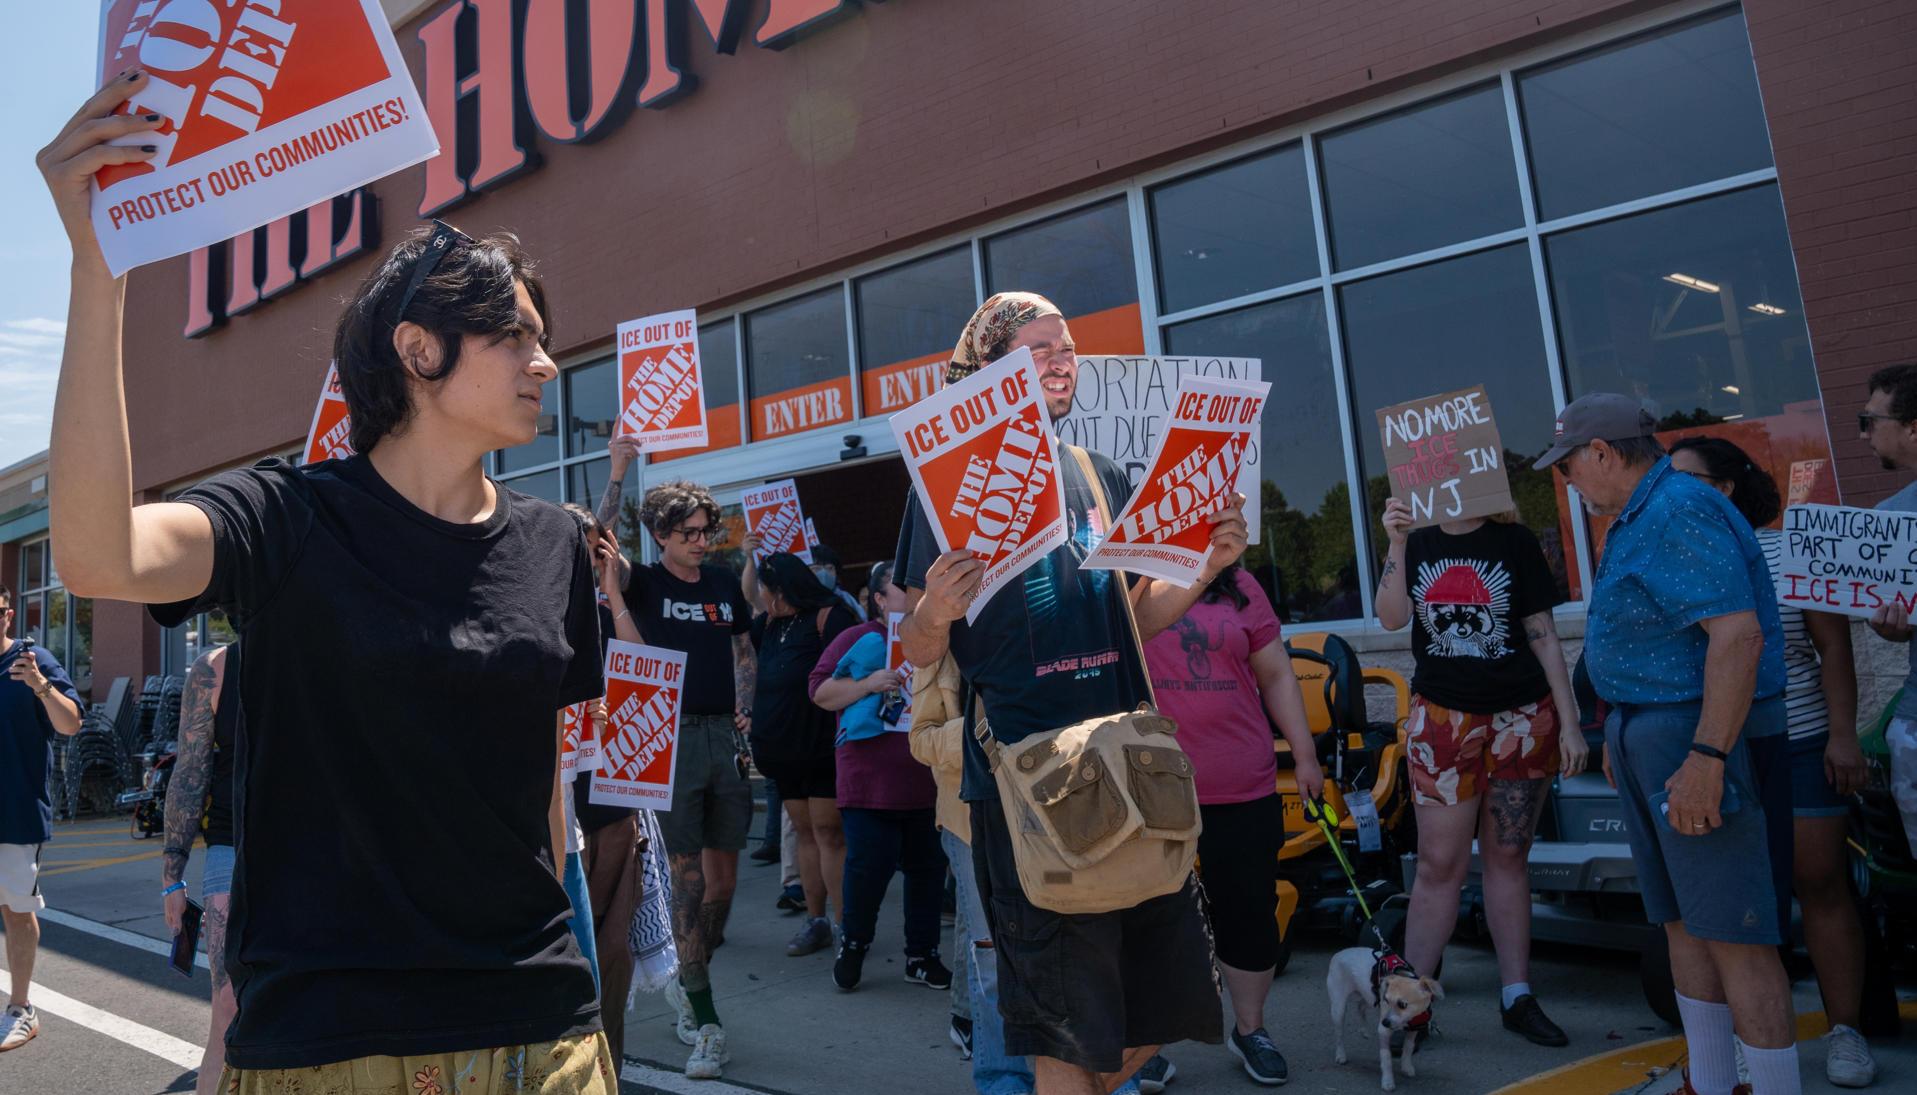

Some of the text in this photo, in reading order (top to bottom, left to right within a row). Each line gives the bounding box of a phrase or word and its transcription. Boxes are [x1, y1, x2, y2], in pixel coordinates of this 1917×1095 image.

[108, 97, 410, 231] PROTECT OUR COMMUNITIES!
[622, 320, 692, 349] ICE OUT OF
[622, 342, 695, 433] HOME
[627, 356, 658, 392] THE
[878, 359, 951, 409] ENTE
[651, 373, 699, 431] DEPOT
[763, 386, 844, 435] ENTER
[904, 368, 1029, 459] ICE OUT OF
[1175, 391, 1262, 424] ICE OUT OF
[1424, 392, 1490, 436] MORE
[1157, 443, 1208, 494] THE
[1391, 445, 1498, 489] THUGS IN
[1407, 432, 1459, 463] ICE
[744, 486, 794, 507] ICE OUT OF
[951, 454, 993, 519] THE
[1000, 451, 1054, 552] DEPOT
[1122, 432, 1246, 543] HOME
[995, 562, 1010, 578] OUR
[1011, 523, 1062, 567] COMMUNITIES!
[1097, 548, 1128, 557] PROTECT
[1143, 549, 1199, 569] COMMUNITIES!
[1789, 532, 1843, 559] PART
[1858, 543, 1893, 564] OF
[1784, 574, 1841, 606] ICE
[1848, 582, 1884, 609] IS
[1808, 560, 1917, 585] COMMUNI
[663, 598, 706, 621] ICE
[609, 652, 682, 683] ICE OUT OF
[1036, 657, 1079, 677] BLADE
[601, 686, 676, 779] HOME
[609, 691, 642, 730] THE
[624, 722, 674, 781] DEPOT
[594, 783, 669, 800] PROTECT OUR COMMUNITIES!
